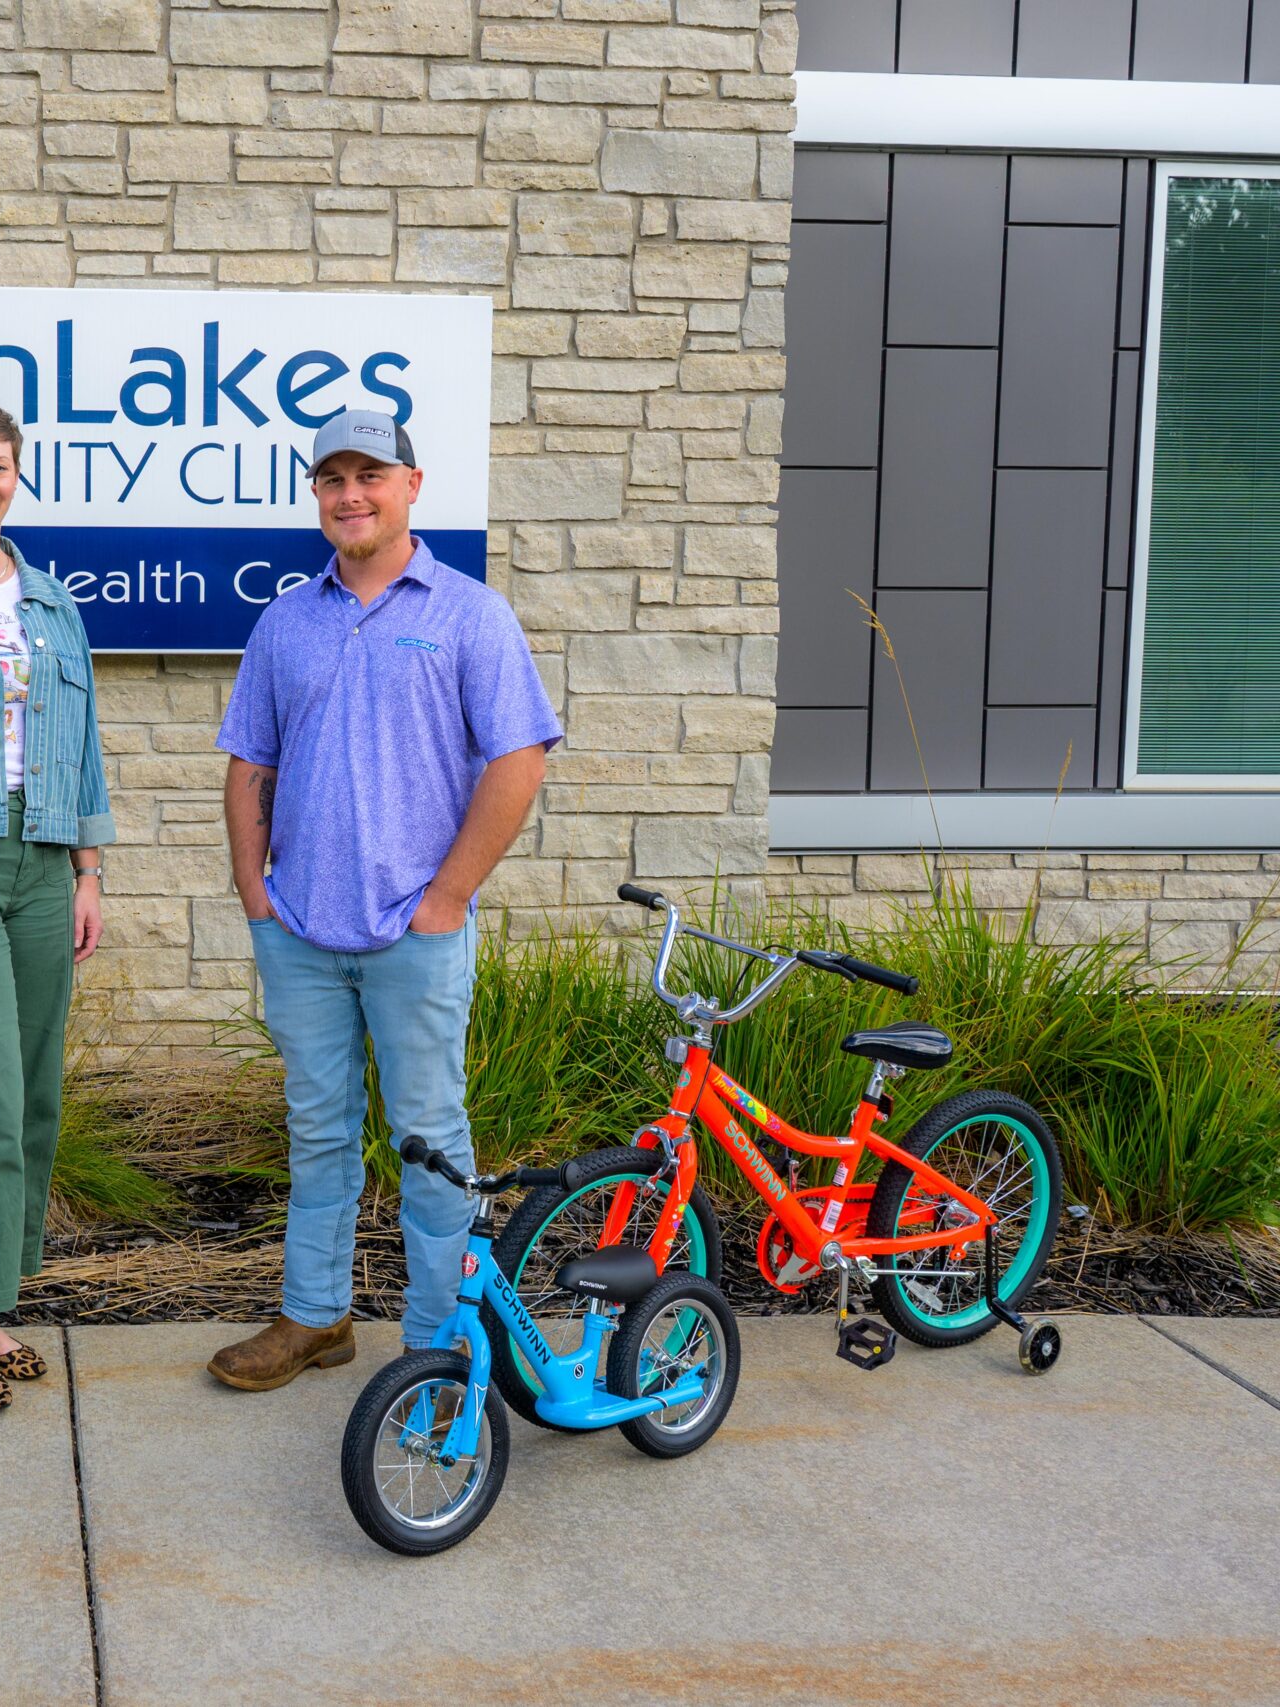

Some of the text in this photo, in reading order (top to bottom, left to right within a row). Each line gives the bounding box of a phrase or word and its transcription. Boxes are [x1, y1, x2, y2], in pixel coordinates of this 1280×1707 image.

[179, 442, 315, 505] CLIN
[724, 1119, 787, 1202] SCHWINN
[493, 1273, 552, 1366] SCHWINN
